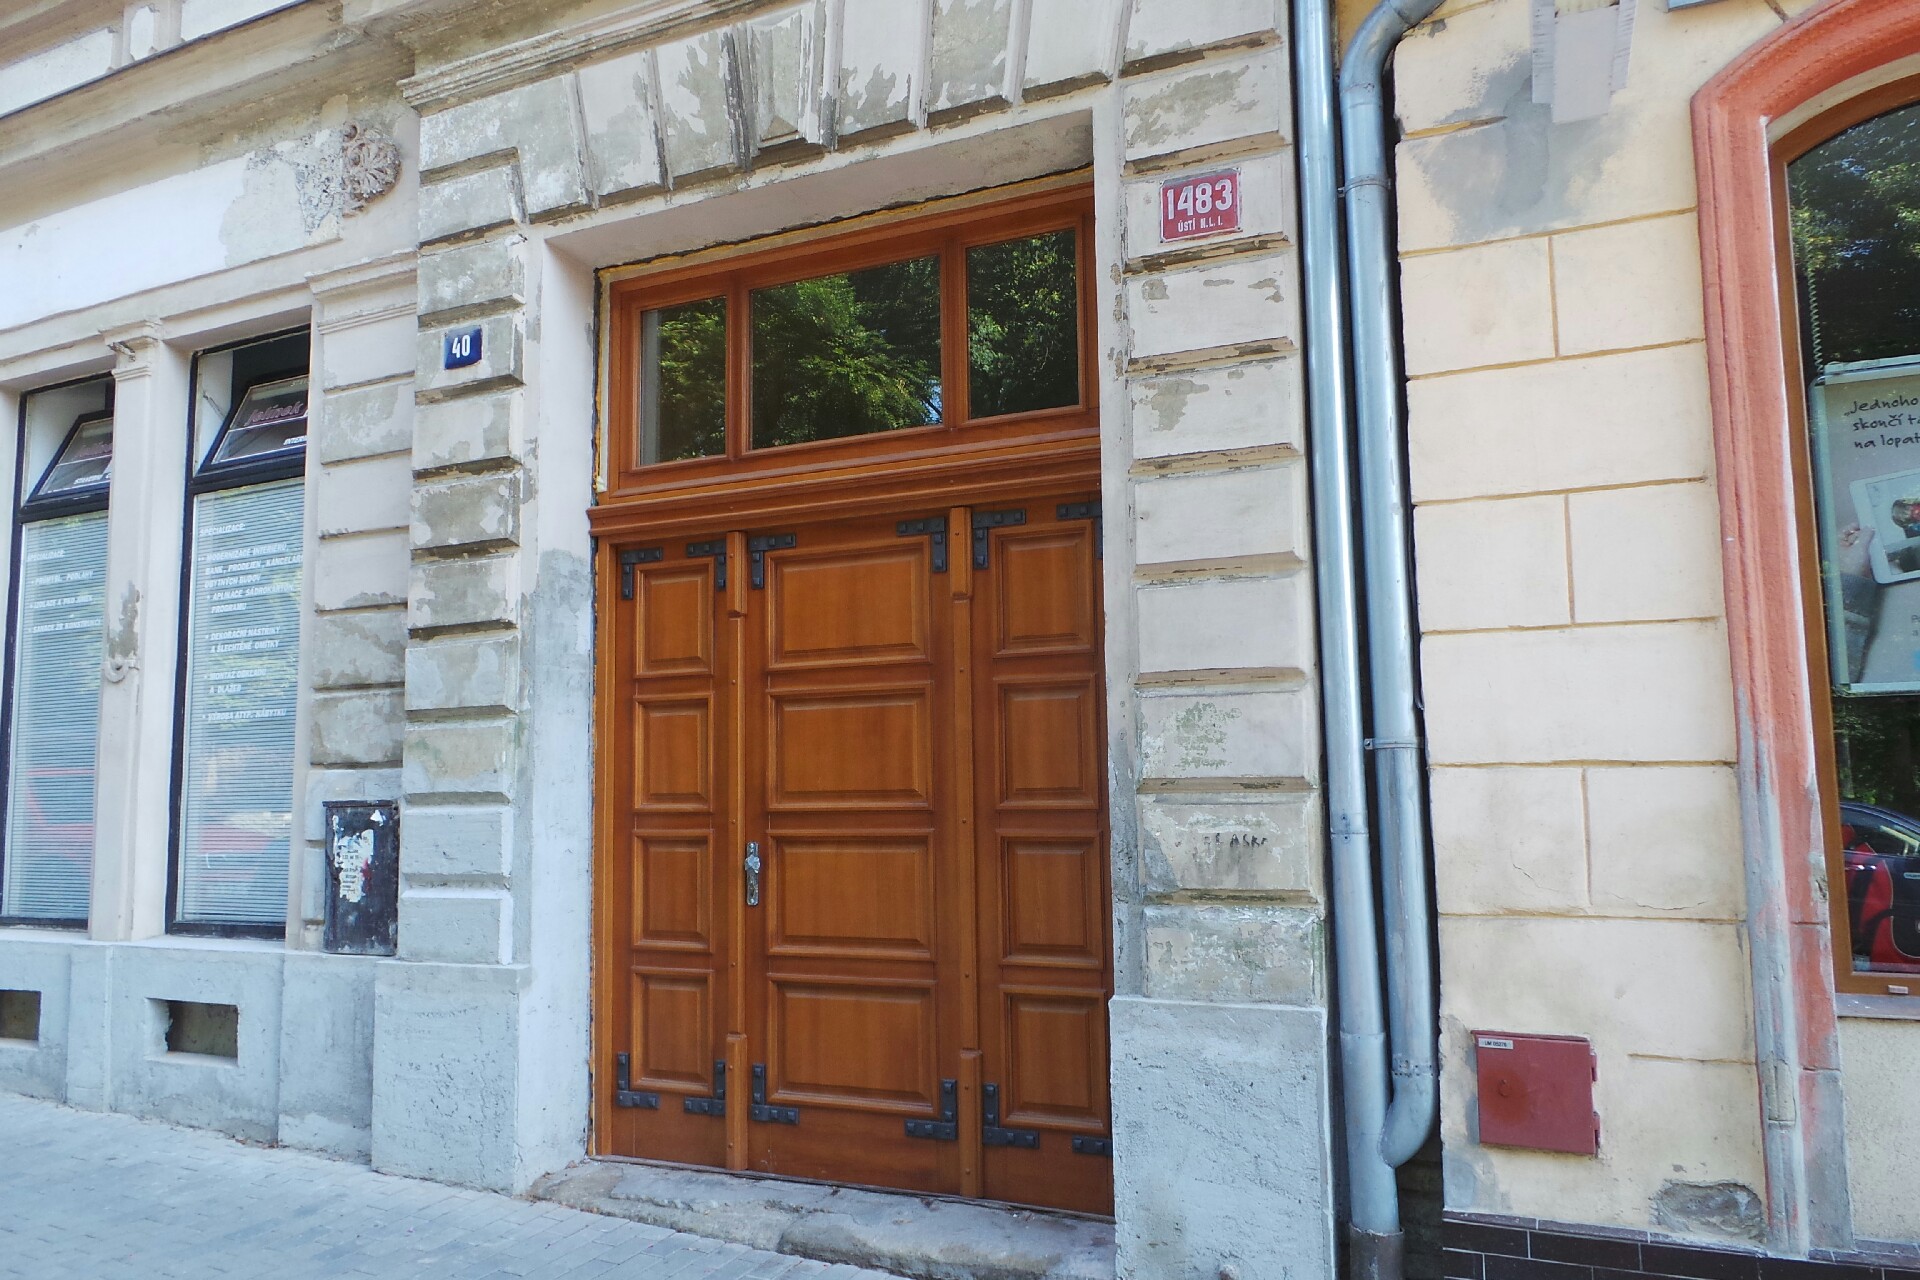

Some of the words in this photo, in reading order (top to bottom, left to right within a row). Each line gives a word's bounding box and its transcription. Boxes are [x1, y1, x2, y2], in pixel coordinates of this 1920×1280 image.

[1167, 179, 1232, 219] 1483
[1178, 218, 1195, 232] ÚSTÍ
[452, 334, 471, 359] 40
[1853, 413, 1903, 431] skončí
[1854, 440, 1876, 449] na
